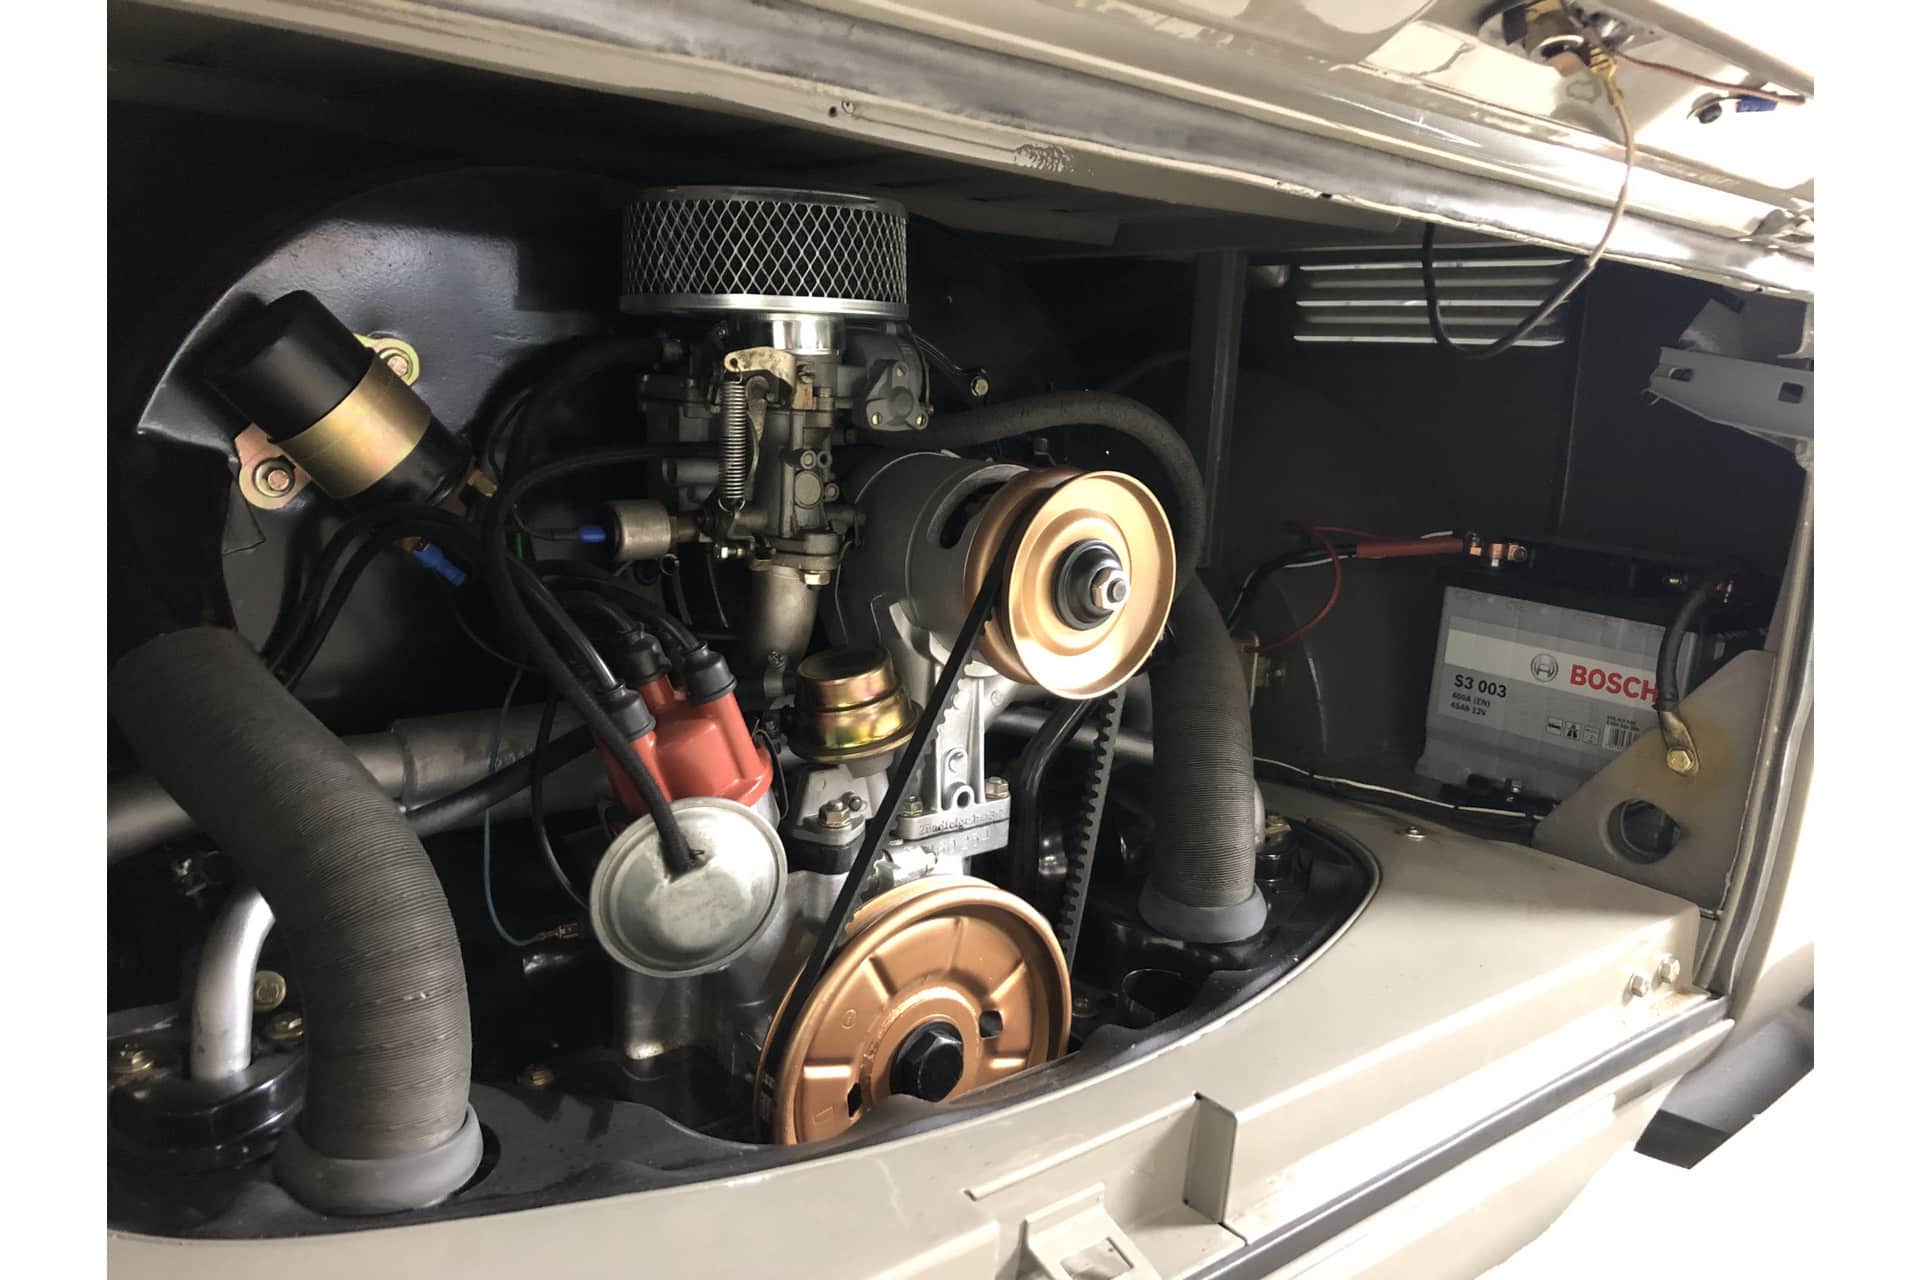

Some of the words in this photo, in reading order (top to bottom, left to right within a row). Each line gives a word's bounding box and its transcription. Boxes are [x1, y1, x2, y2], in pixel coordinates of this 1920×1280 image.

[1454, 674, 1474, 690] S3
[1478, 680, 1507, 698] 003
[1570, 664, 1658, 702] BOSCH
